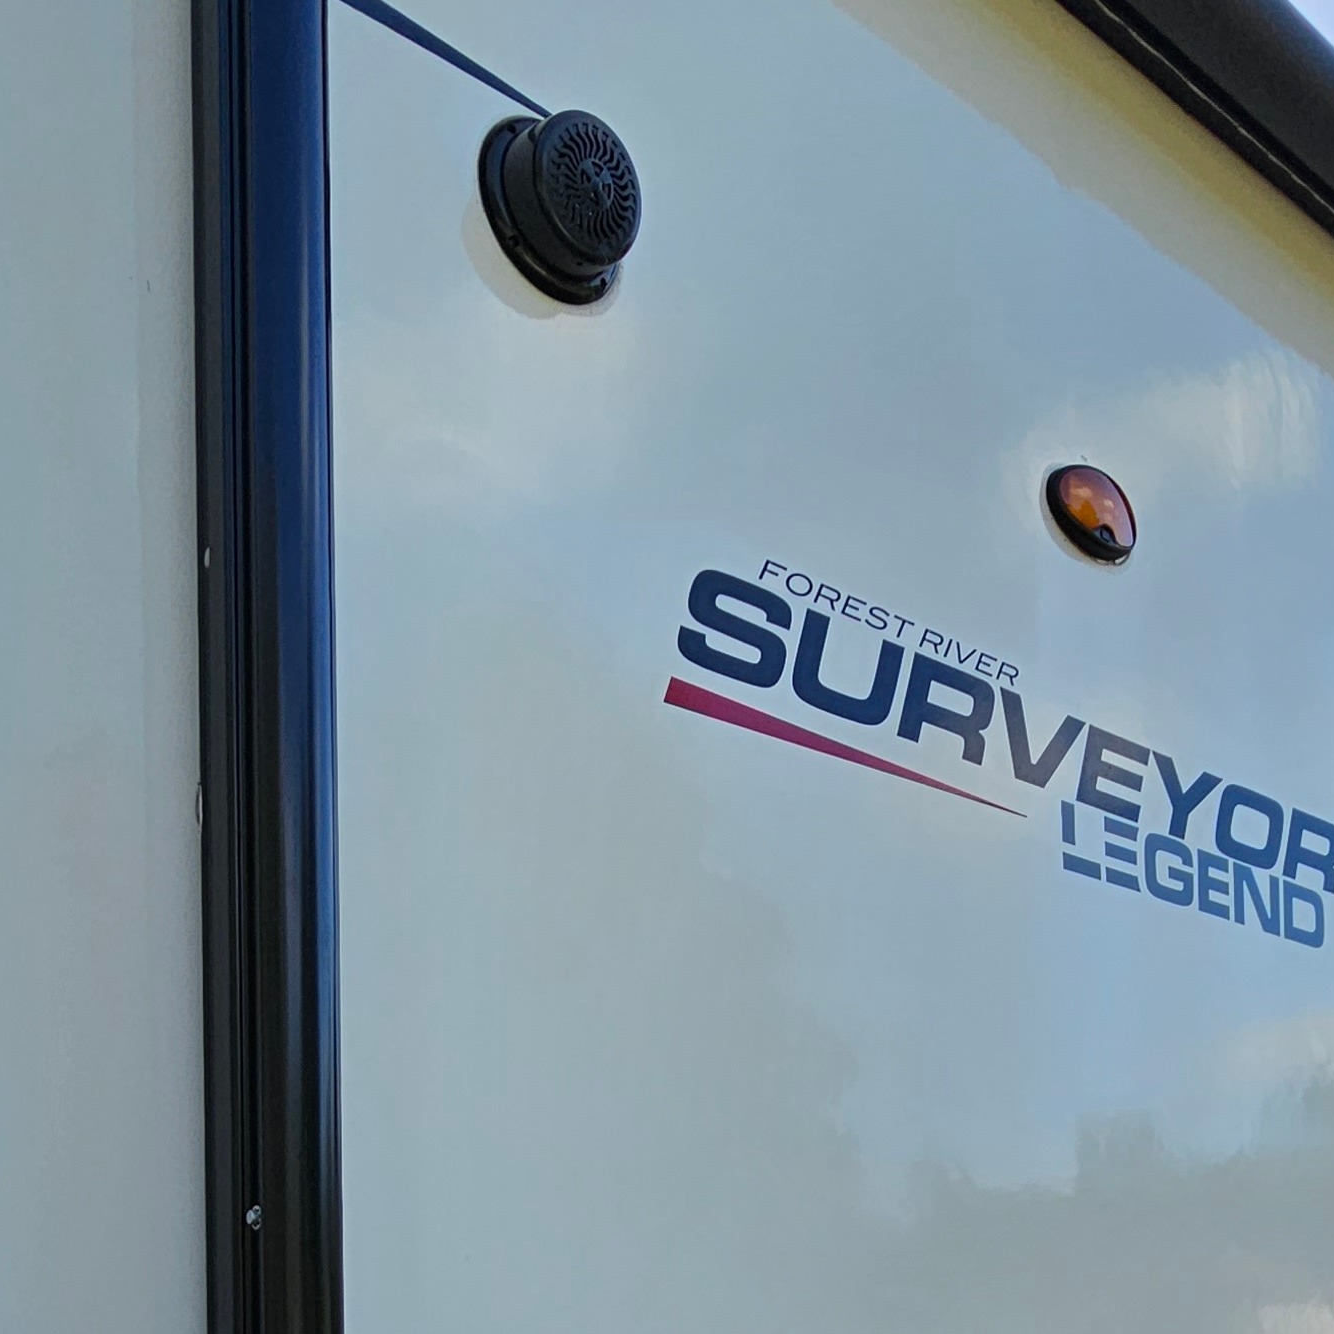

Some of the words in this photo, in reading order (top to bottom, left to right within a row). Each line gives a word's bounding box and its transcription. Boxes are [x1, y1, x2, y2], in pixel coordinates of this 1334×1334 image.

[758, 559, 914, 639] FOREST
[919, 627, 1020, 687] RIVER
[1061, 800, 1325, 949] LEGEND
